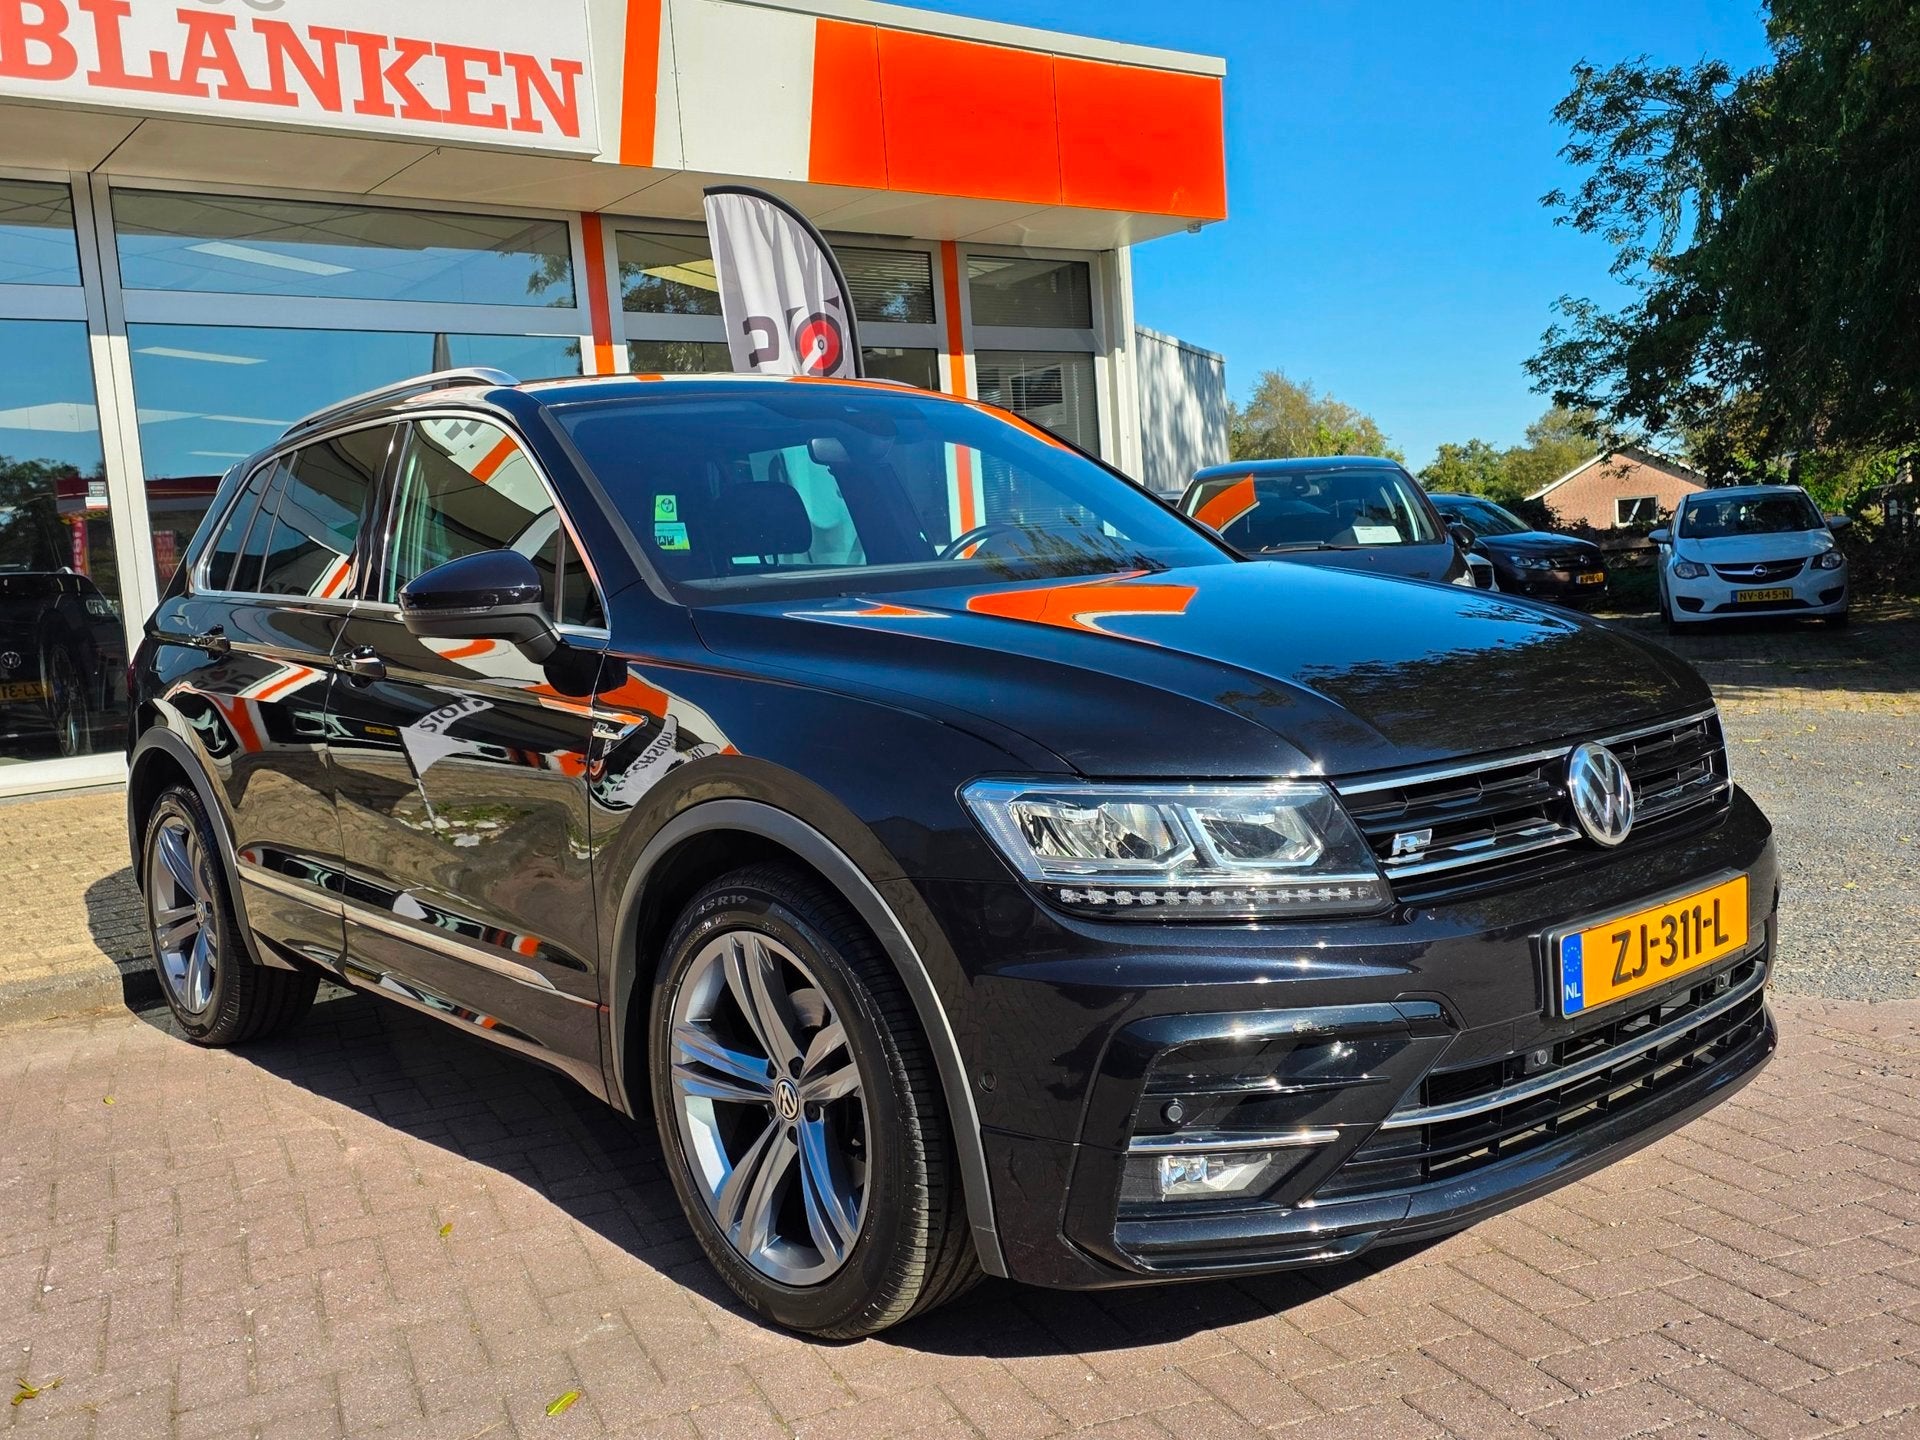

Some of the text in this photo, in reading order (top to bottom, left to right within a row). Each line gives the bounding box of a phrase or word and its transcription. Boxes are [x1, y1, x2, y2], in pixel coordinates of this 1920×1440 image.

[0, 0, 583, 138] BLANKEN
[1611, 898, 1729, 987] ZJ-311-L
[1565, 982, 1581, 999] NL
